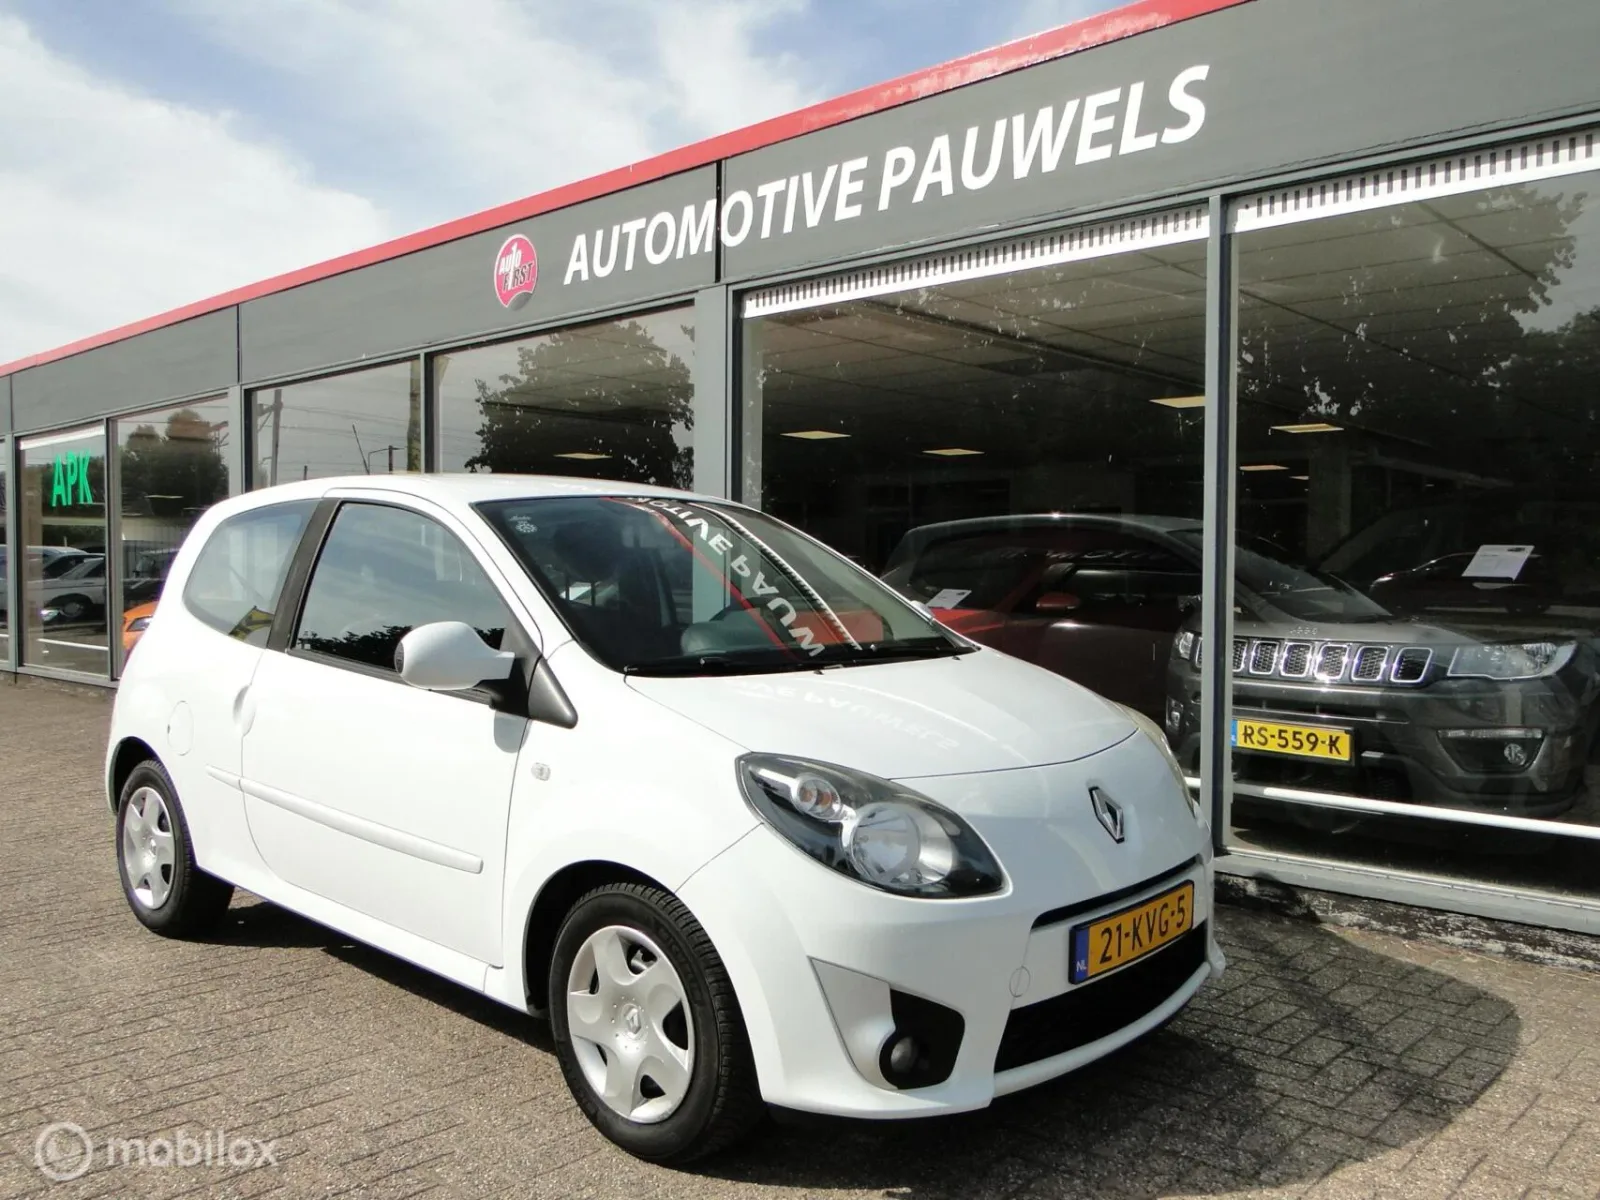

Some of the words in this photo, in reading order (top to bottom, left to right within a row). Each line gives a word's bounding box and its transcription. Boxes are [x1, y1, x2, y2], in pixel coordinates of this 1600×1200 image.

[563, 155, 868, 286] AUTOMOTIVE
[877, 64, 1210, 212] PAUWELS
[52, 449, 93, 506] APK
[1242, 724, 1342, 756] RS-559-K
[1099, 893, 1186, 965] 21-KVG-5
[1076, 959, 1088, 973] NL
